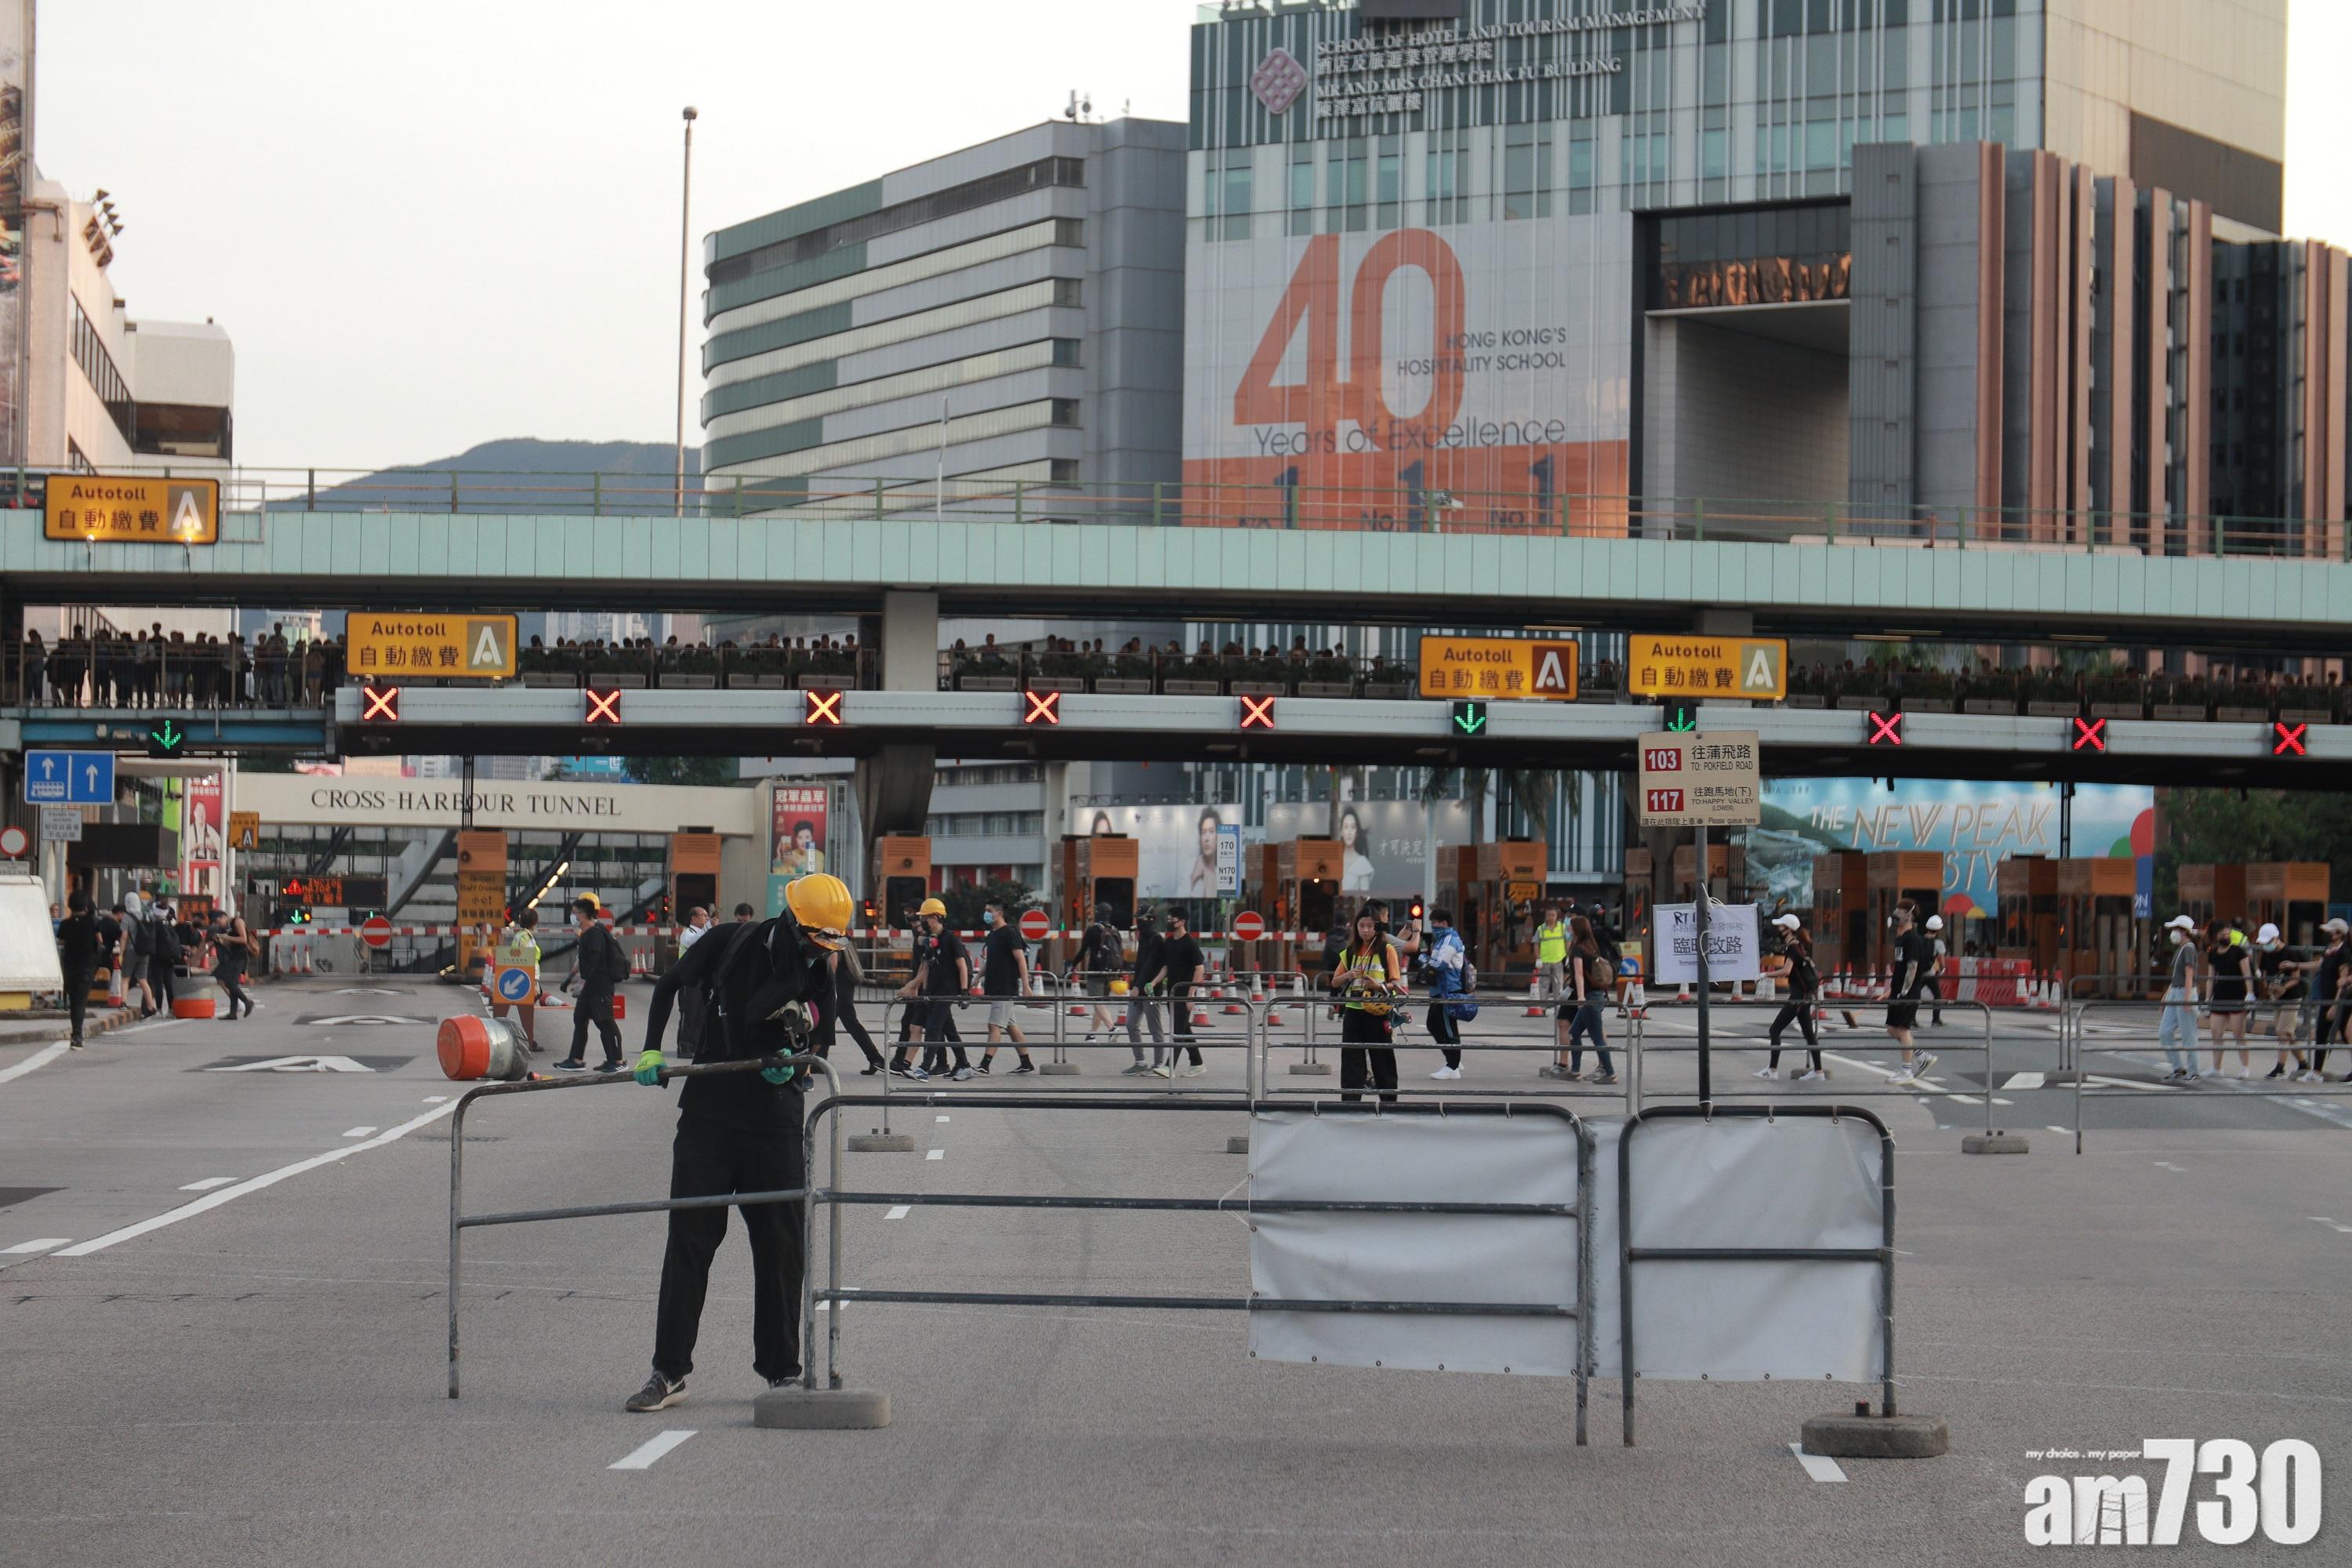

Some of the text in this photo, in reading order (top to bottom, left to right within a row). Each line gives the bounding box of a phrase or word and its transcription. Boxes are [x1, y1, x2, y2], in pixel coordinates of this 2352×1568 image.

[1317, 5, 1706, 55] SCHOOL OF HOTEL AND TOURISM MANAGEMENT
[1317, 56, 1622, 97] MR AND MRS CHAN CHAK FU BUILDING
[1233, 227, 1466, 452] 40
[1446, 327, 1566, 350] HONG KONG'S
[1397, 351, 1566, 376] HOSPITALITY SCHOOL
[1254, 416, 1566, 457] Years of Excellence
[71, 483, 146, 501] Autotoll
[1529, 453, 1555, 526] 1
[60, 508, 159, 532] 自動繳費
[371, 620, 446, 637] Autotoll
[360, 645, 459, 667] 自動繳費
[1443, 647, 1512, 663] Autotoll
[1651, 642, 1722, 659] Autotoll
[1429, 668, 1524, 691] 自動繳費
[1642, 666, 1734, 689] 自動繳費
[1648, 750, 1677, 770] 103
[1691, 745, 1751, 760] 往蒲飛路
[1690, 760, 1754, 771] TO: POKFIELD ROAD
[1650, 791, 1679, 811] 117
[1693, 786, 1751, 797] 往跑馬地(下)
[527, 793, 622, 817] TUNNEL
[1811, 801, 2056, 848] THE NEW PEAK
[1220, 840, 1234, 850] 170
[1218, 866, 1236, 875] N170
